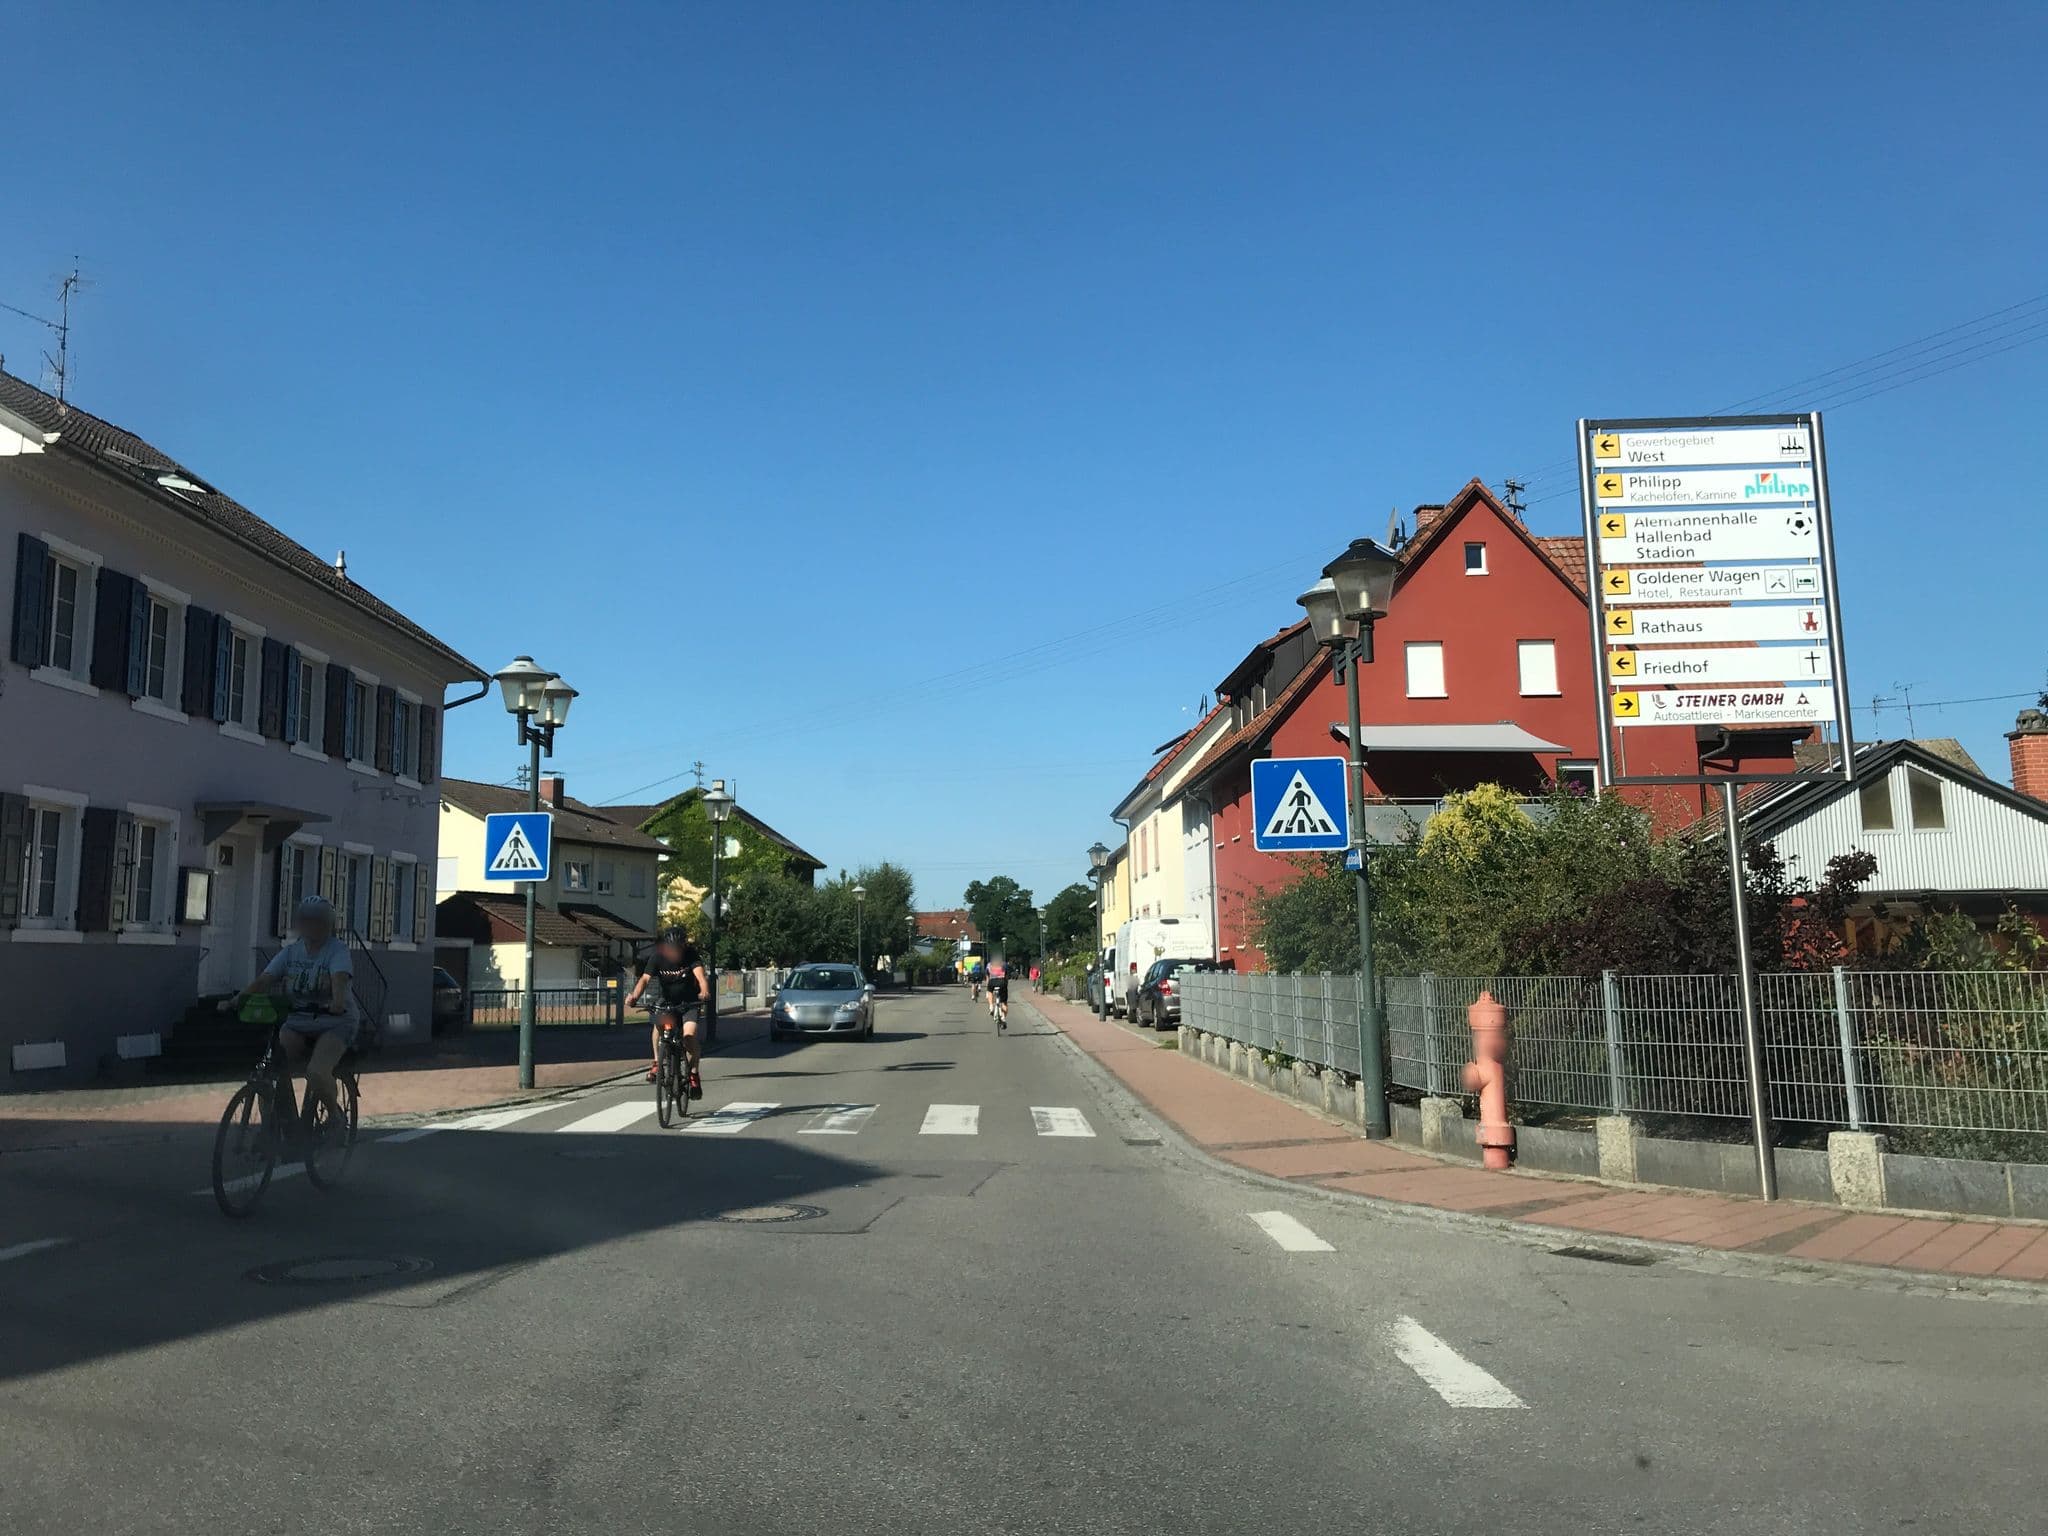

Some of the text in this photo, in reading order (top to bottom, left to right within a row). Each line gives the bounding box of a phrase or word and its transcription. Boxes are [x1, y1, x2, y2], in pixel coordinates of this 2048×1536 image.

[1626, 435, 1716, 449] Gewerbegebiet
[1628, 451, 1665, 463] West
[1629, 475, 1682, 490] Philipp
[1744, 473, 1810, 499] philipp
[1695, 489, 1737, 501] Kamine
[1634, 512, 1758, 528] Alemannenhalle
[1635, 529, 1712, 543] Hallenbad
[1637, 546, 1695, 559] Stadion
[1637, 570, 1761, 585] Goldener Wagen
[1638, 587, 1743, 599] Hotel, Restaurant
[1641, 621, 1703, 634] Rathaus
[1644, 660, 1709, 675] Friedhof
[1675, 693, 1785, 708] STEINER GMBH
[1654, 708, 1723, 722] Autosattlerei
[1734, 708, 1819, 720] Markisencenter
